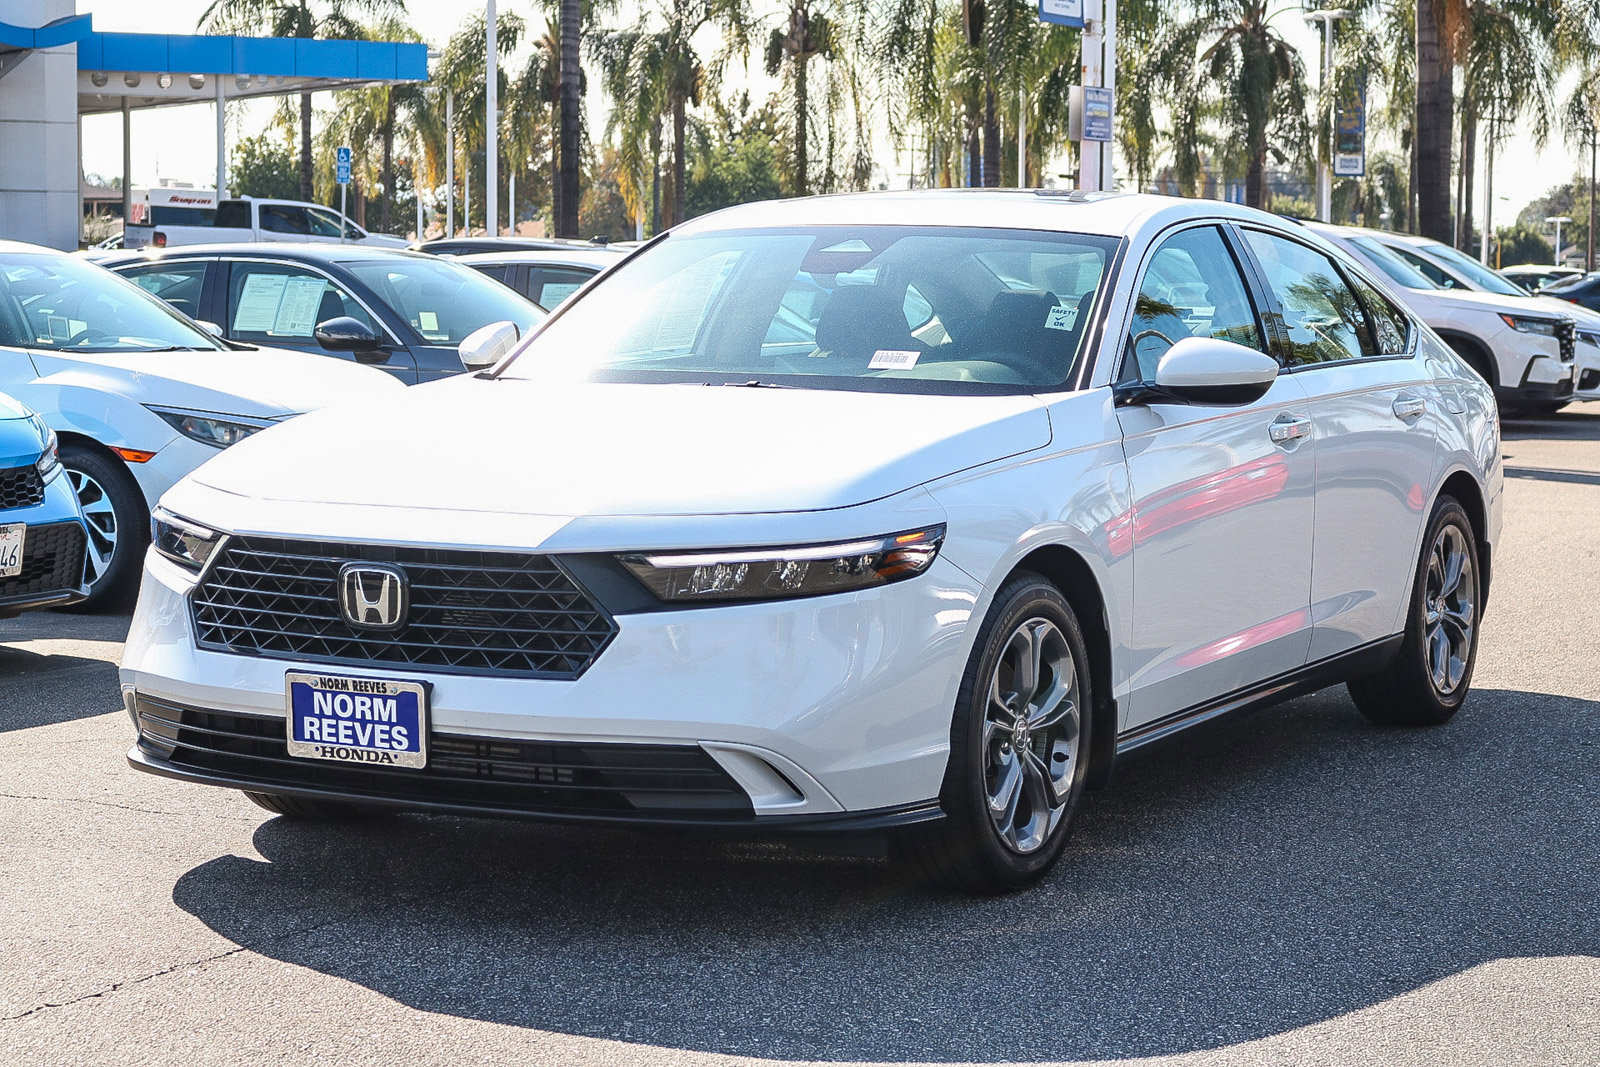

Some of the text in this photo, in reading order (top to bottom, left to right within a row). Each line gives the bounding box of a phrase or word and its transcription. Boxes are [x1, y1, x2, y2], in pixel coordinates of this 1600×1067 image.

[1051, 308, 1076, 316] SAFETY
[320, 677, 387, 694] NORM REEVES
[313, 691, 397, 723] NORM
[304, 716, 409, 750] REEVES
[320, 746, 395, 764] HONDA
